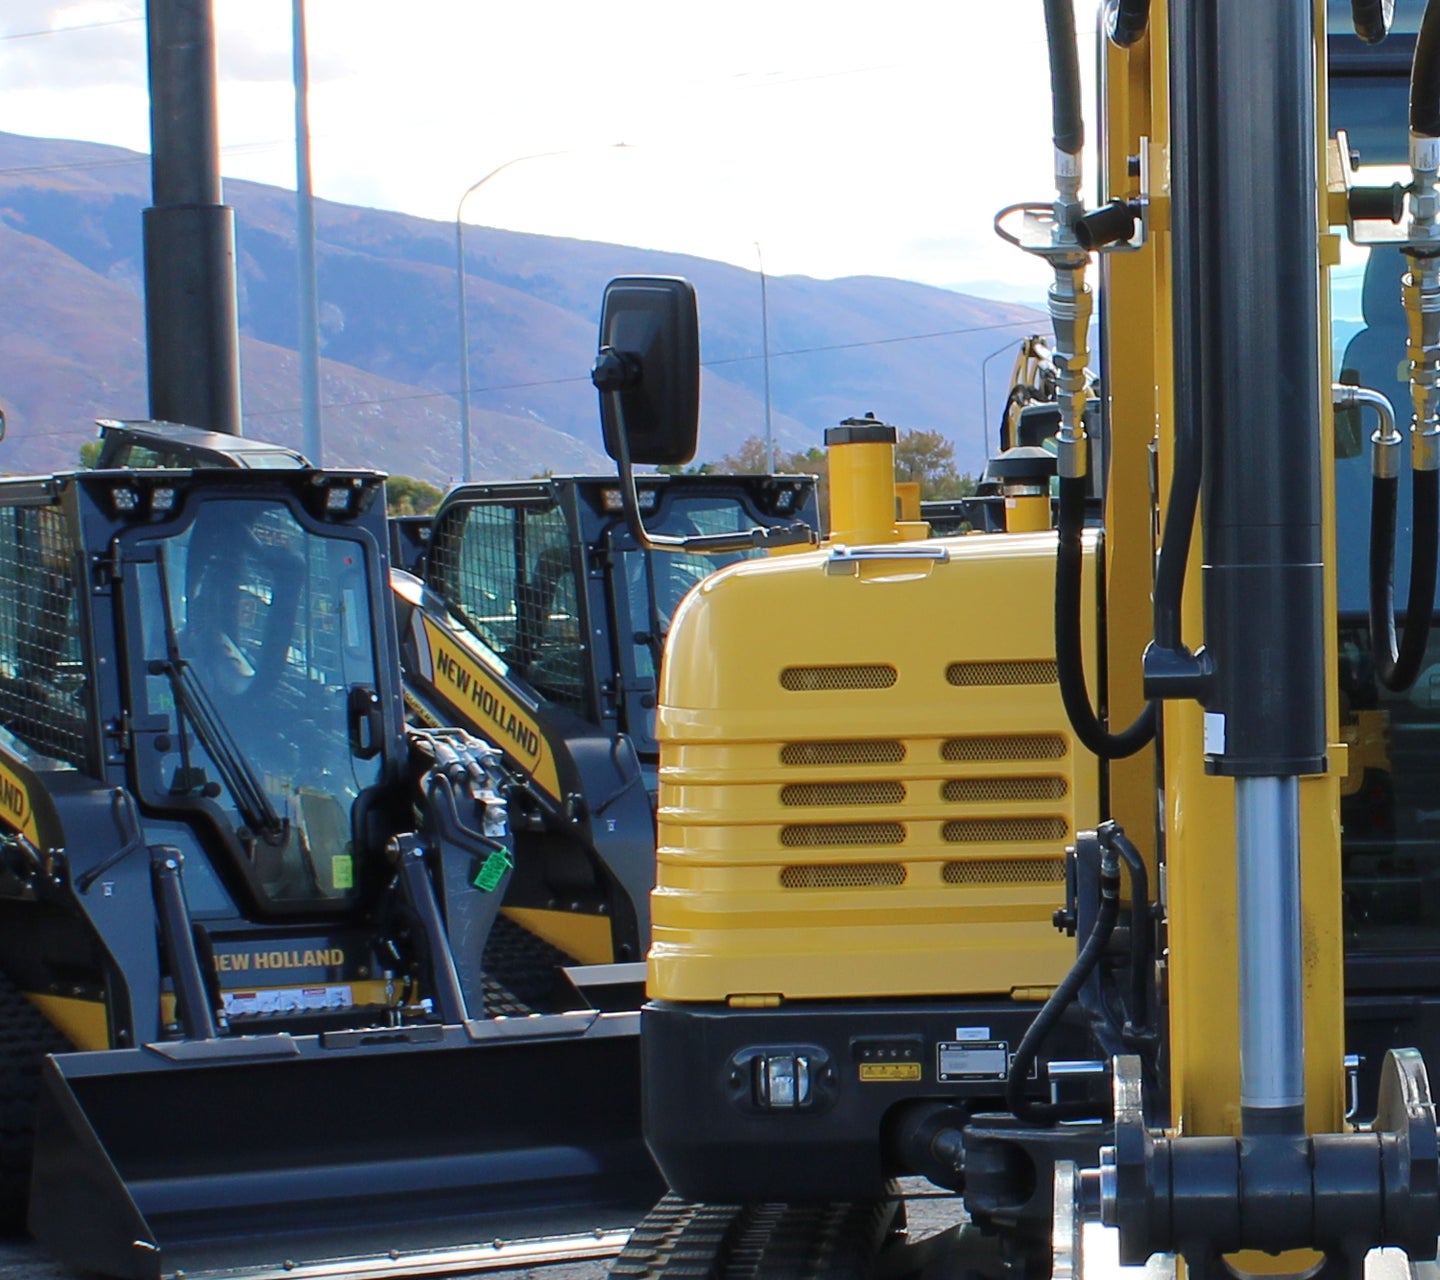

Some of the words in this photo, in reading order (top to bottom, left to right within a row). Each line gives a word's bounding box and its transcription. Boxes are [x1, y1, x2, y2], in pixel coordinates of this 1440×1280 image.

[436, 648, 471, 694] NEW
[472, 679, 539, 757] HOLLAND
[255, 949, 344, 969] HOLLAND
